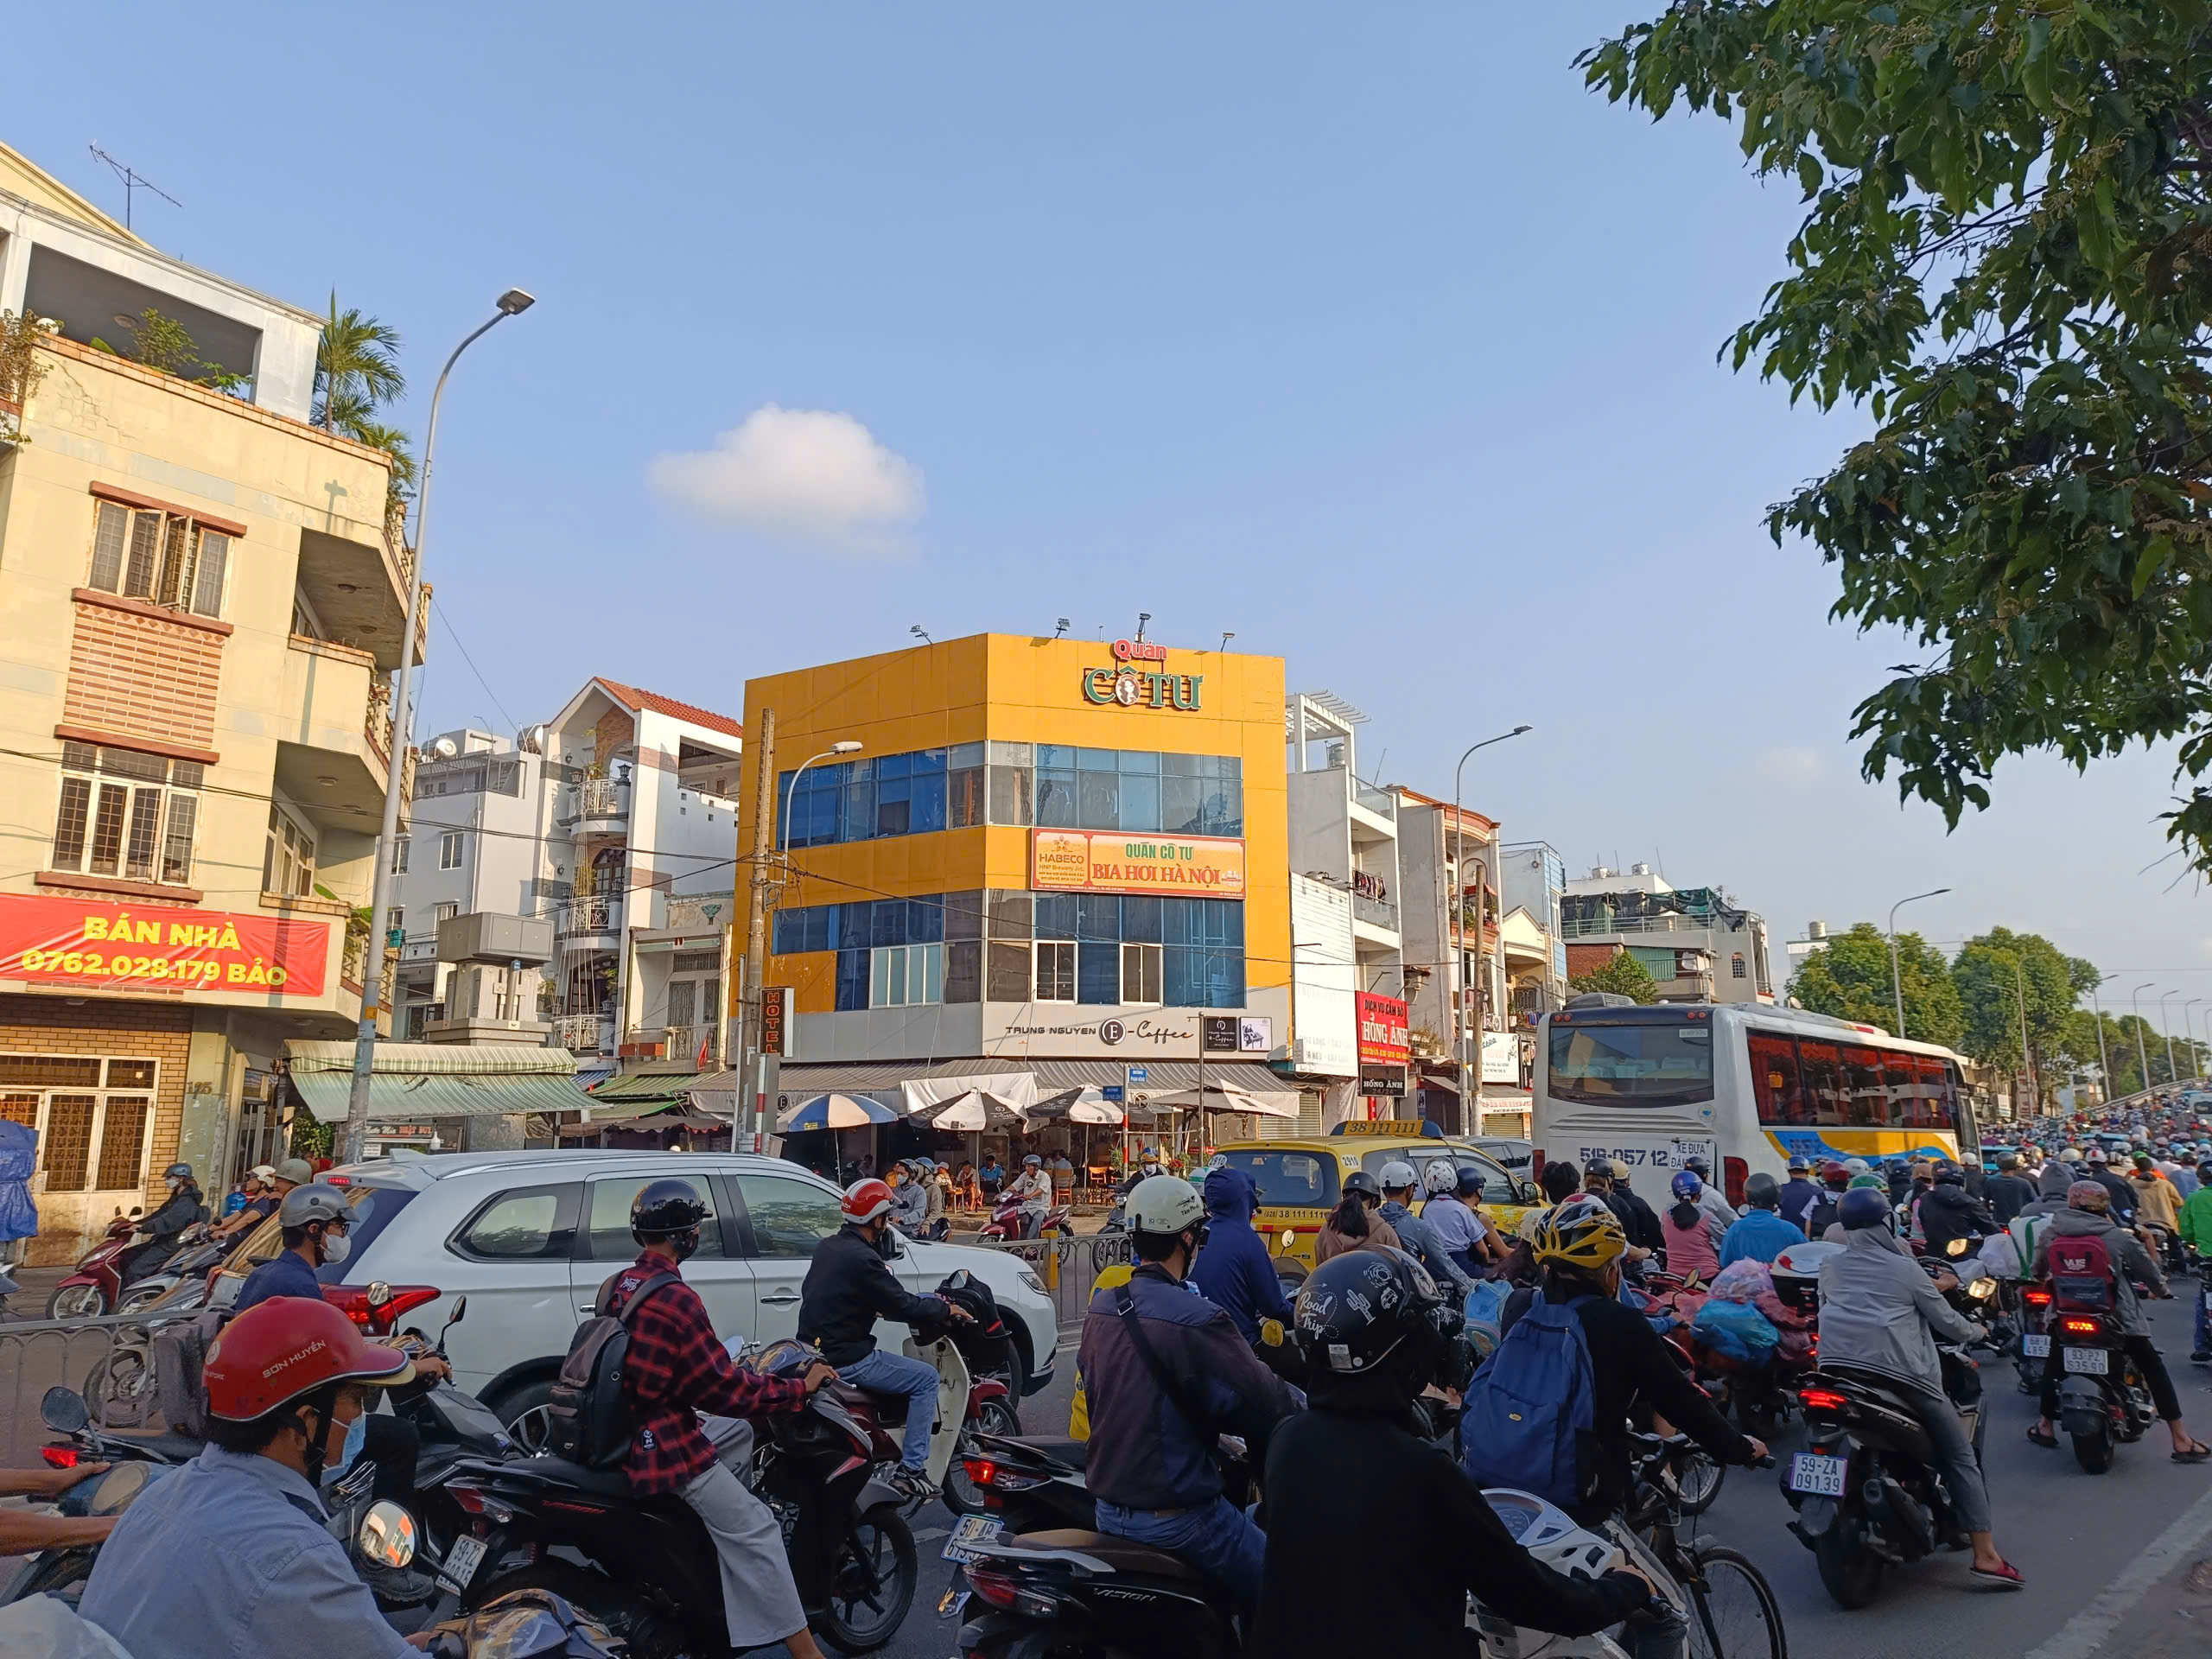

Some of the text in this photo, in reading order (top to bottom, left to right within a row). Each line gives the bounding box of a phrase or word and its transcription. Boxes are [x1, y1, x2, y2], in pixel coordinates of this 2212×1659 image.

[1114, 639, 1167, 660] Quán
[1144, 672, 1204, 709] TƯ
[1039, 853, 1084, 864] HABECO
[1126, 842, 1193, 861] QUÁN CÔ TƯ
[1092, 863, 1222, 888] BIA HƠI HÀ NỘI
[84, 912, 241, 951] BÁN NHÀ
[21, 949, 287, 986] 0762.028.179 BẢO
[766, 992, 780, 1054] HOTEL
[1006, 1027, 1046, 1035] TRUNG
[1049, 1027, 1096, 1035] NGUYEN
[1349, 1122, 1367, 1133] 38
[1395, 1122, 1416, 1133] 111
[1676, 1142, 1706, 1154] XE ĐƯA
[1342, 1155, 1360, 1166] 2910
[1263, 1210, 1278, 1218] (028)
[1300, 1290, 1333, 1315] Road
[1301, 1312, 1325, 1340] Trip
[1802, 1457, 1838, 1476] 59-ZA
[1796, 1472, 1840, 1492] 091.39
